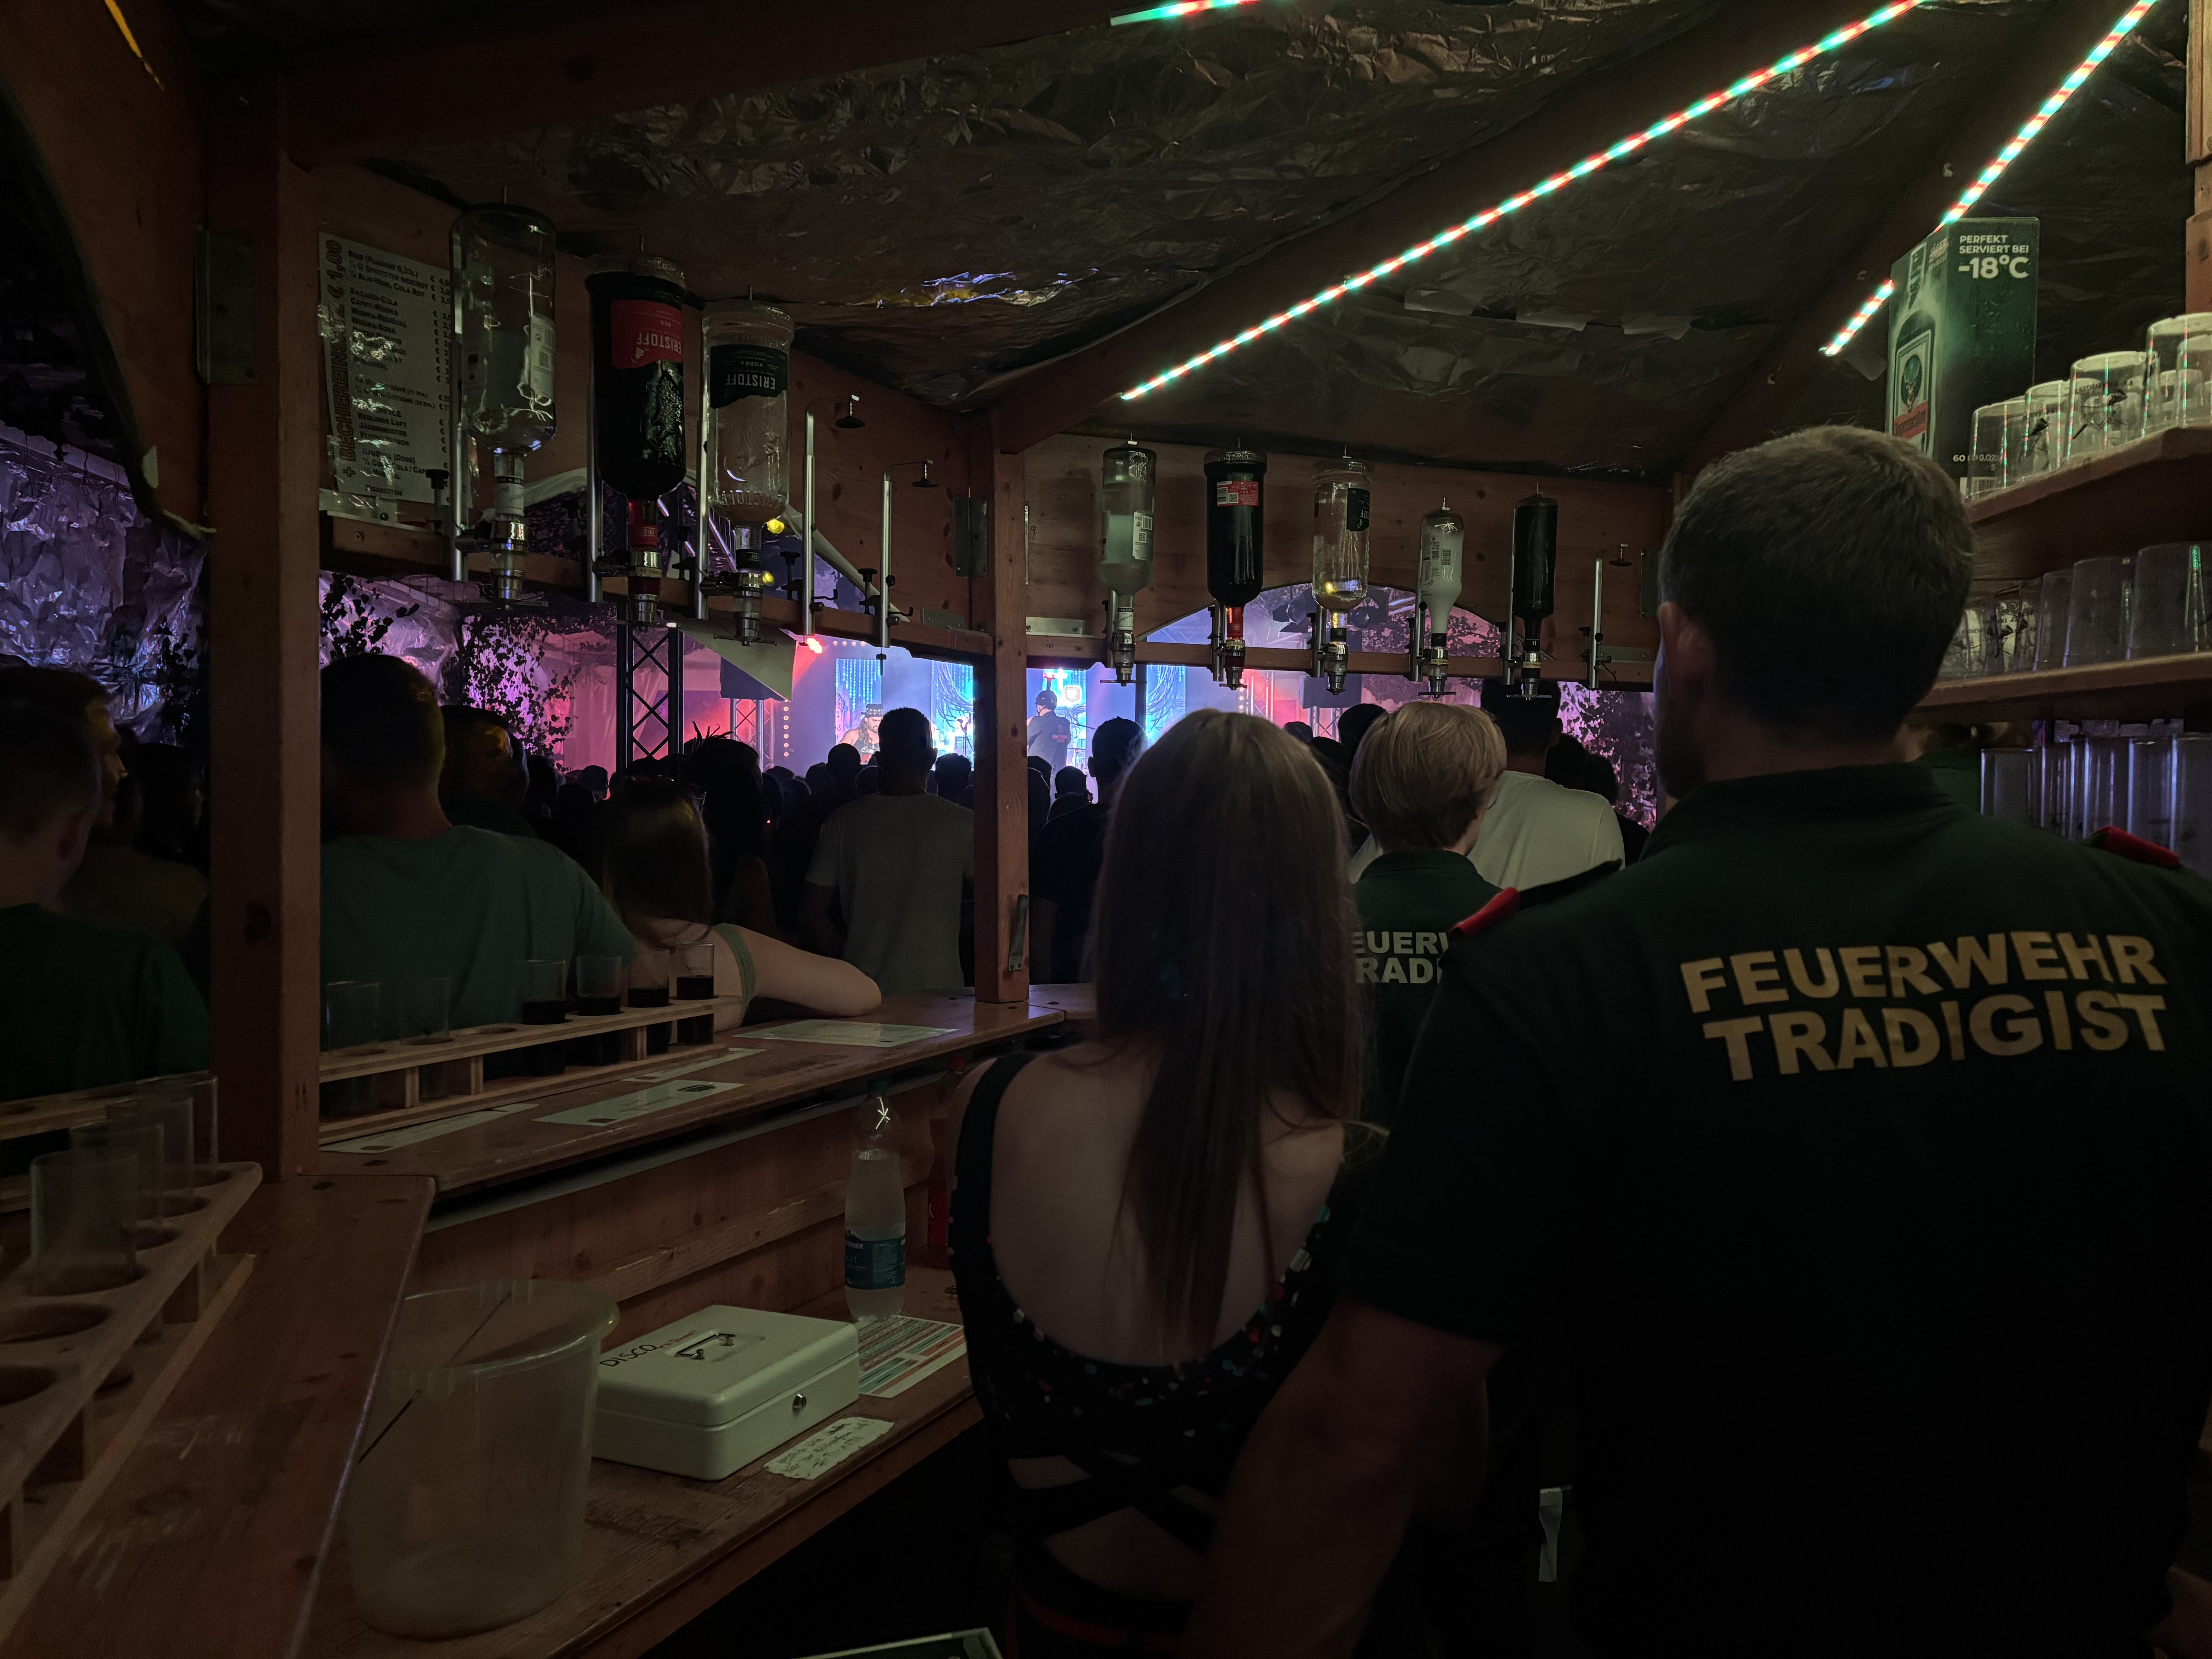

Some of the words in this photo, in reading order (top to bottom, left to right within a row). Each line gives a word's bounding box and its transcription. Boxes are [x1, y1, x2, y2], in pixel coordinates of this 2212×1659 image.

[1959, 235, 2008, 244] PERFEKT
[1959, 245, 2011, 254] SERVIERT
[2011, 245, 2029, 254] BEI
[326, 239, 346, 280] 1,00
[1958, 254, 2029, 279] -18°C
[327, 284, 344, 299] €
[394, 283, 410, 293] COLA
[412, 289, 425, 297] ROT
[350, 297, 398, 316] CAPPY-WODKA
[350, 307, 407, 328] WODKA-REDBULL
[351, 316, 396, 334] WODKA-SODA
[635, 332, 682, 354] ERISTOFF
[725, 373, 776, 390] ERISTOFF
[357, 412, 390, 425] BERLINER
[391, 418, 407, 428] LUFT
[359, 422, 407, 437] JÄGERMEISTER
[393, 453, 415, 465] (DOSE)
[1953, 454, 1966, 462] 60
[365, 484, 402, 496] ZGARETTEN
[1680, 931, 2169, 1014] FEUERWEHR
[1702, 990, 2167, 1082] TRADIGIST
[599, 1345, 658, 1367] DISCO
